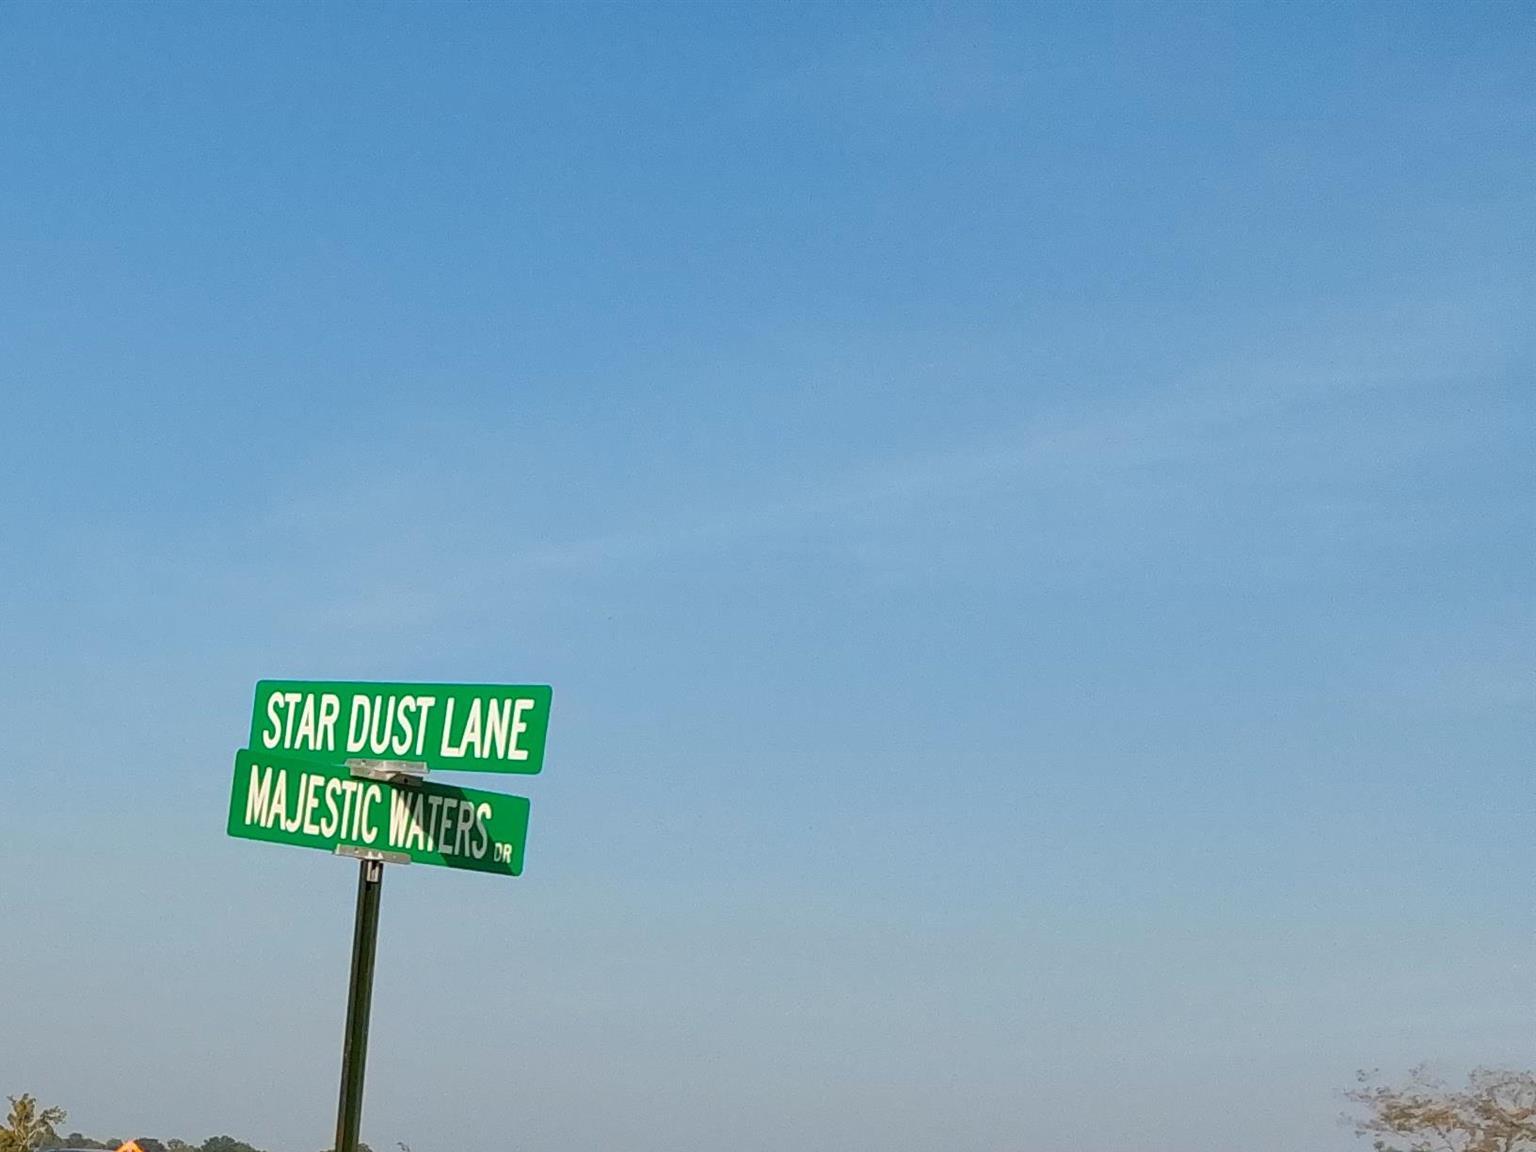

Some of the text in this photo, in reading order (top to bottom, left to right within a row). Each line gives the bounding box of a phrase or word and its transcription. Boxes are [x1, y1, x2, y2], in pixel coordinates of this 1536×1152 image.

[262, 691, 535, 761] STAR DUST LANE
[244, 764, 513, 864] MAJESTIC WATERS DR
